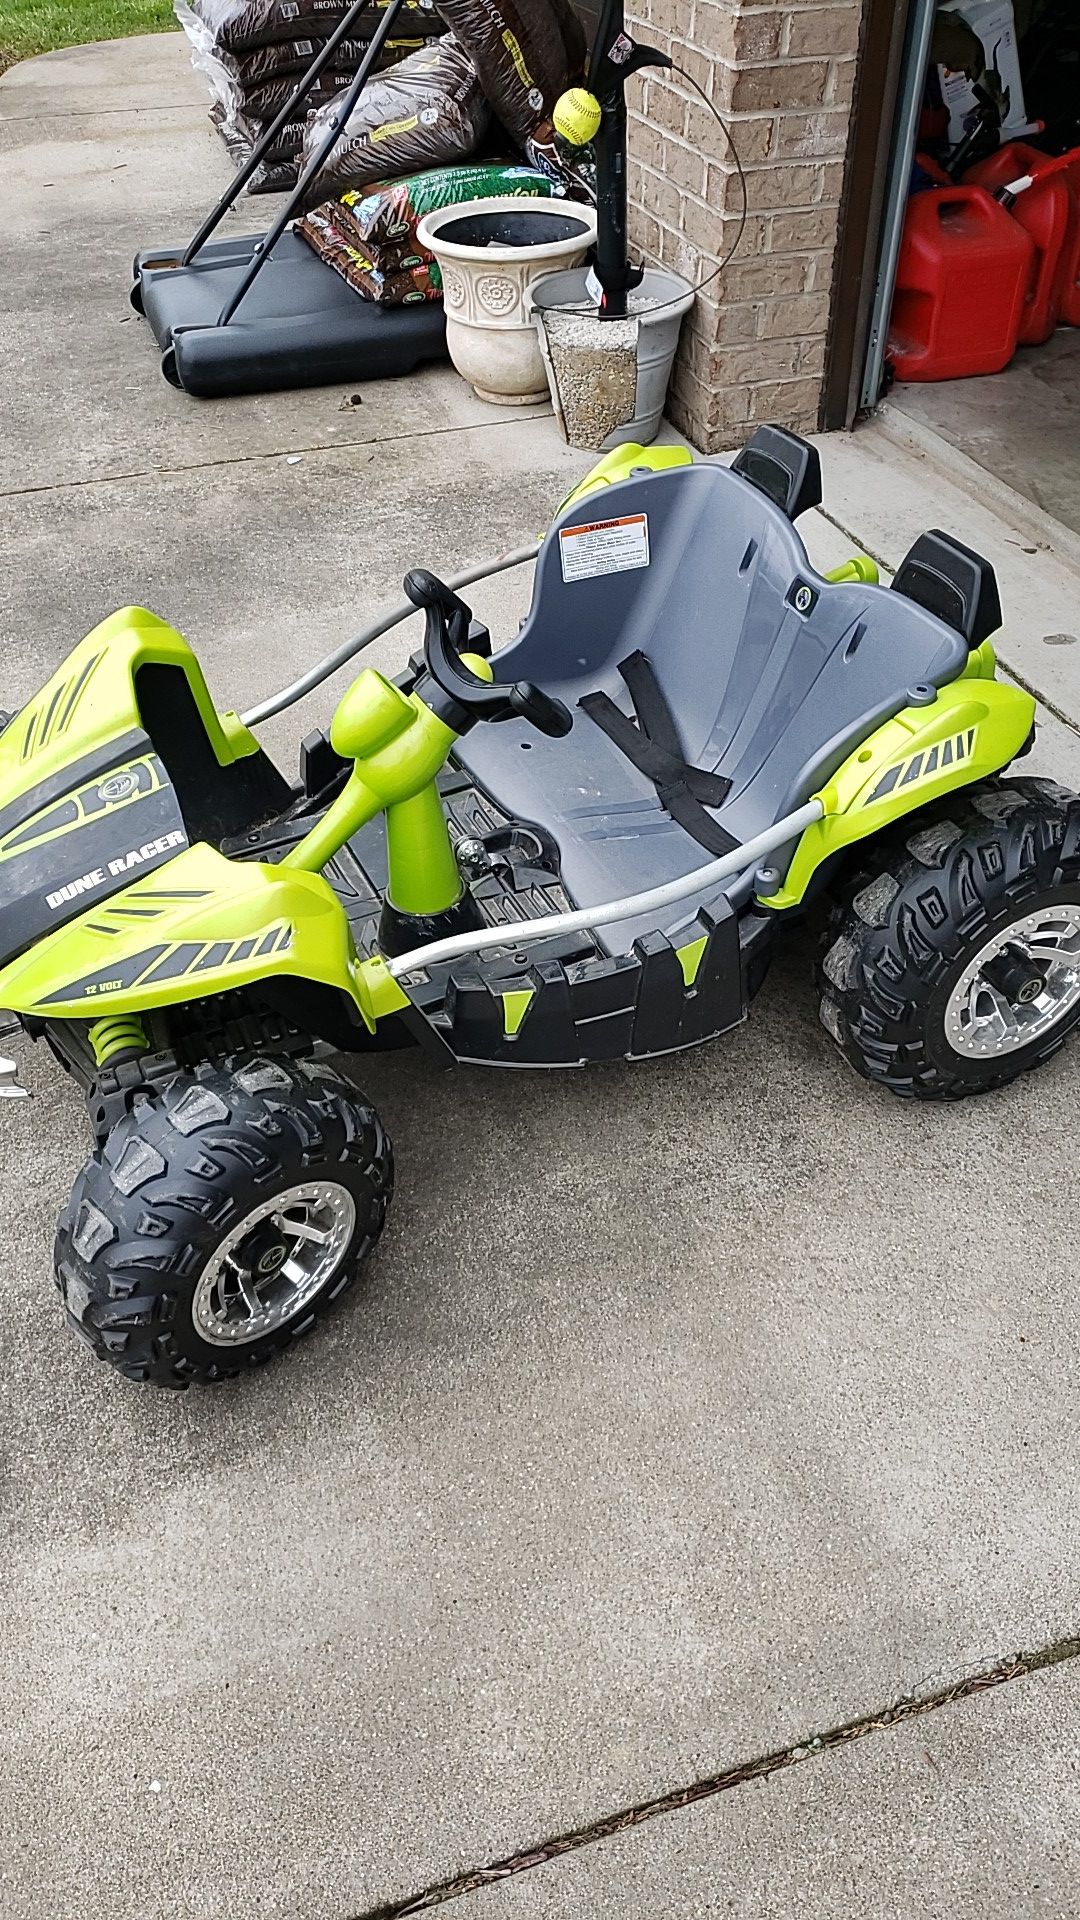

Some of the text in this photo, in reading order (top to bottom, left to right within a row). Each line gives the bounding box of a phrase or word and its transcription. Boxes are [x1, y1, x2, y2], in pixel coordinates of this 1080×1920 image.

[314, 0, 343, 9] BROWN
[335, 76, 354, 85] BRO
[283, 122, 306, 134] BROW
[332, 135, 367, 158] MULCH
[589, 520, 620, 531] WARNING
[45, 830, 185, 909] DUNE RACER
[85, 980, 122, 994] 12 VOLT
